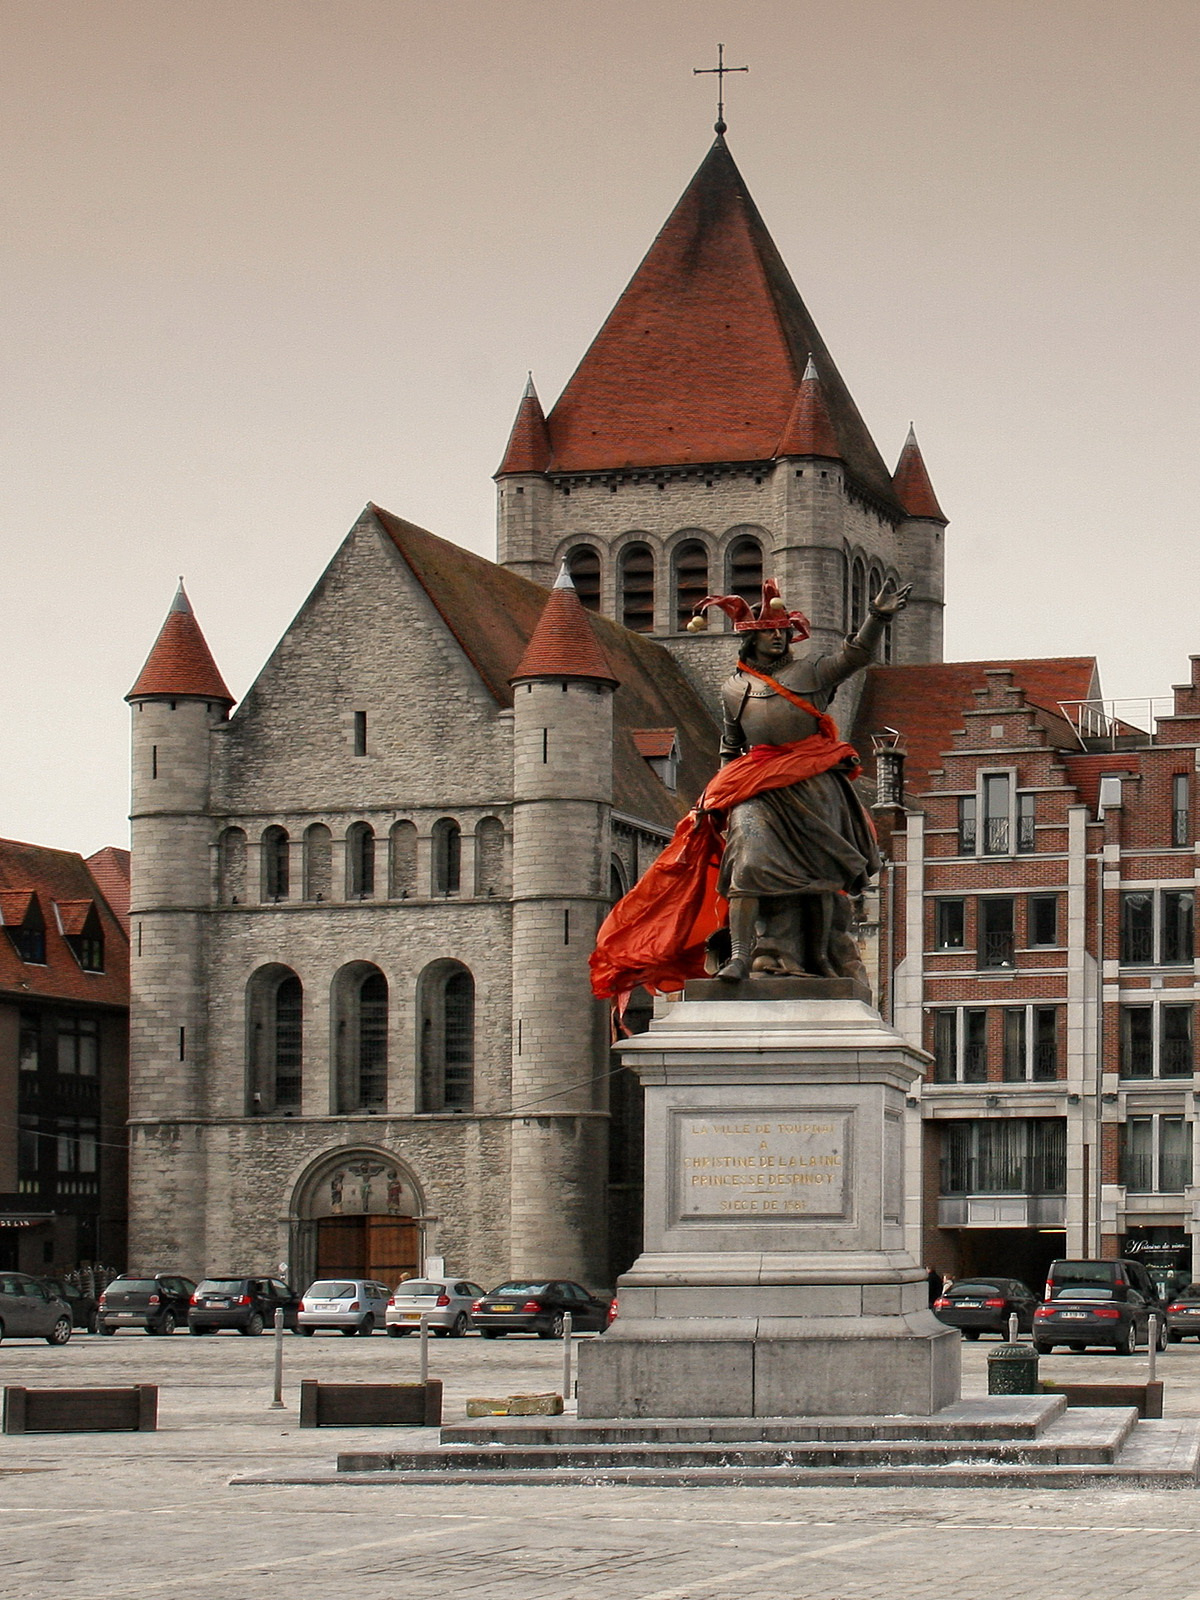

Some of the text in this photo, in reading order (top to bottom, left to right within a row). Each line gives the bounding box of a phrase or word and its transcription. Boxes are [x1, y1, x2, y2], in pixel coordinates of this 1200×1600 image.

[692, 1124, 835, 1134] LA VILLE DE TOURNAI
[684, 1156, 756, 1168] CHRISTINE
[759, 1156, 775, 1168] DE
[691, 1174, 765, 1186] PRINCESSE
[763, 1200, 778, 1210] DE
